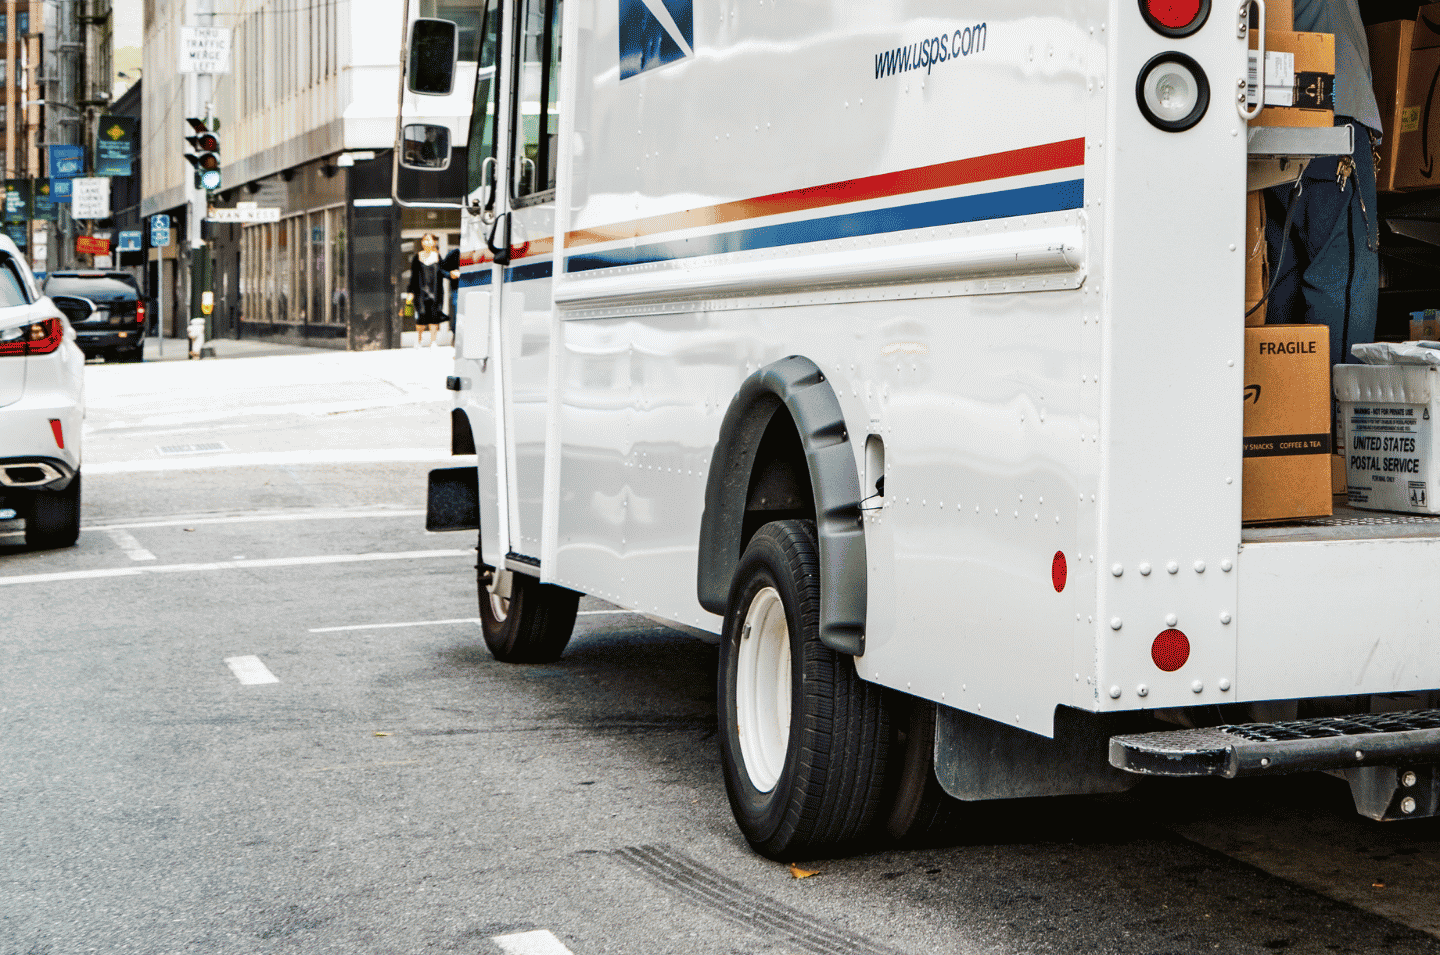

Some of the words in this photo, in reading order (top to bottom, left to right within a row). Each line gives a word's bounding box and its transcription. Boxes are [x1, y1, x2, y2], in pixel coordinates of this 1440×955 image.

[186, 39, 225, 49] TRAFFIC
[189, 50, 220, 60] MERGE
[874, 22, 988, 81] www.usps.com
[218, 211, 241, 219] VAN
[248, 211, 276, 219] NESS
[1259, 340, 1316, 355] FRAGILE
[1249, 442, 1274, 451] SNACKS
[1279, 441, 1303, 450] COFFEE
[1309, 440, 1322, 448] TEA
[1353, 436, 1382, 451] UNITED
[1383, 437, 1416, 453] STATES
[1350, 455, 1381, 471] POSTAL
[1383, 457, 1419, 473] SERVICE
